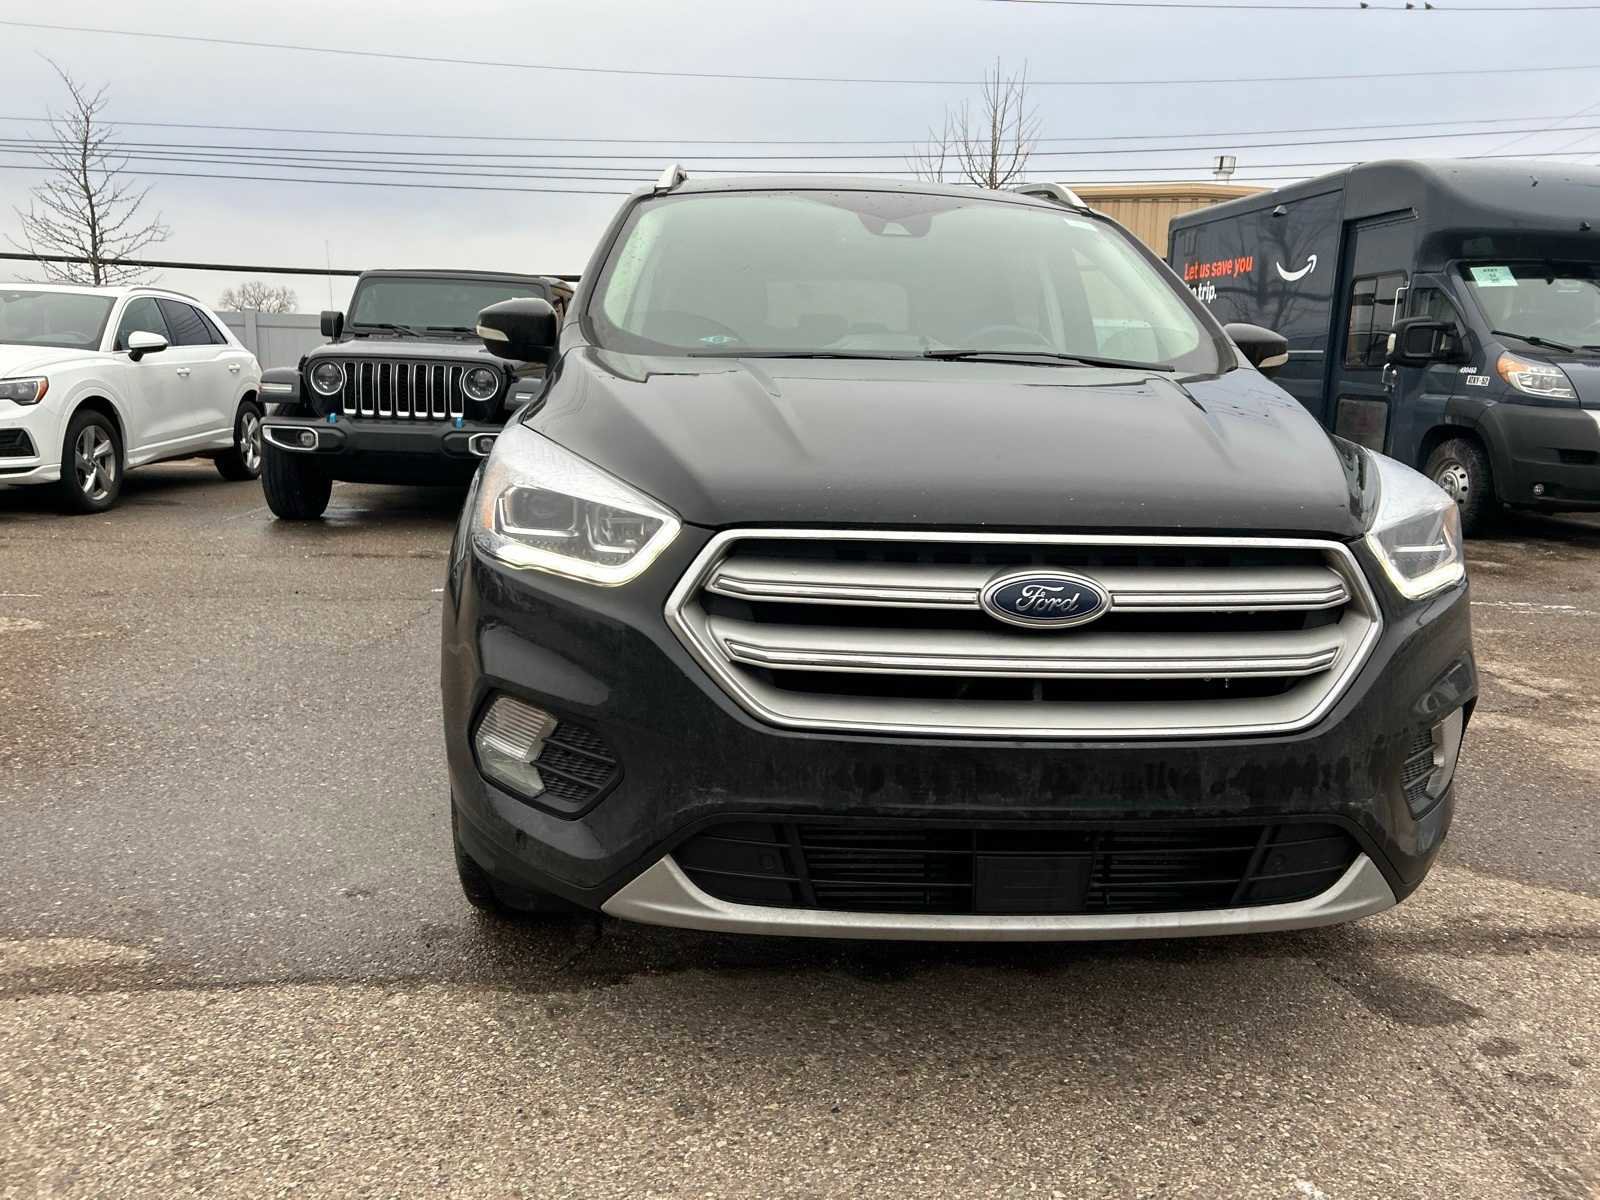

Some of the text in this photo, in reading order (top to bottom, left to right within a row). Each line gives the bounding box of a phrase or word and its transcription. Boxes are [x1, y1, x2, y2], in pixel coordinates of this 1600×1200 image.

[1184, 256, 1253, 280] Let us save you
[1198, 281, 1217, 304] trip.
[1016, 584, 1080, 612] Ford
